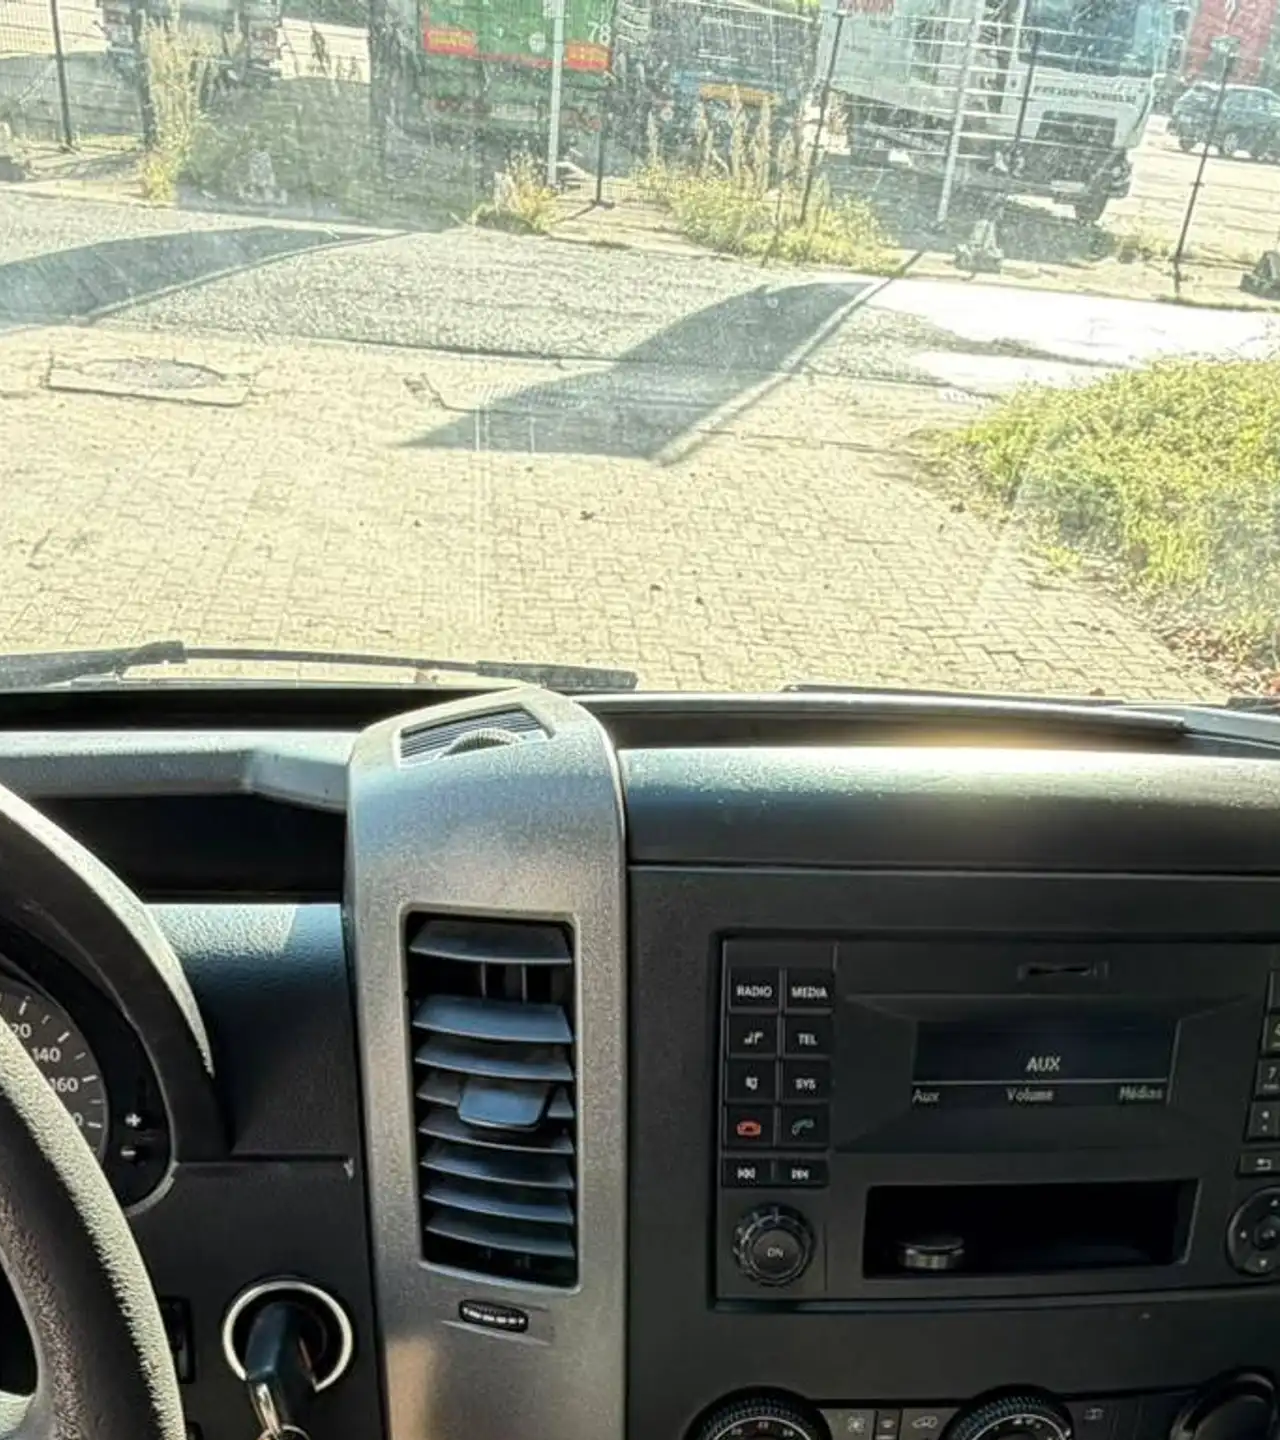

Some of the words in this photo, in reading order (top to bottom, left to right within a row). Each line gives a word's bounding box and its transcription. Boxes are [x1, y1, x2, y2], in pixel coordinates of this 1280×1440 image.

[735, 983, 773, 999] RADIO
[790, 984, 829, 1001] MEDIA
[796, 1032, 820, 1047] TEL
[1023, 1055, 1062, 1073] AUX
[911, 1087, 941, 1105] Aux
[1006, 1086, 1056, 1103] Volume
